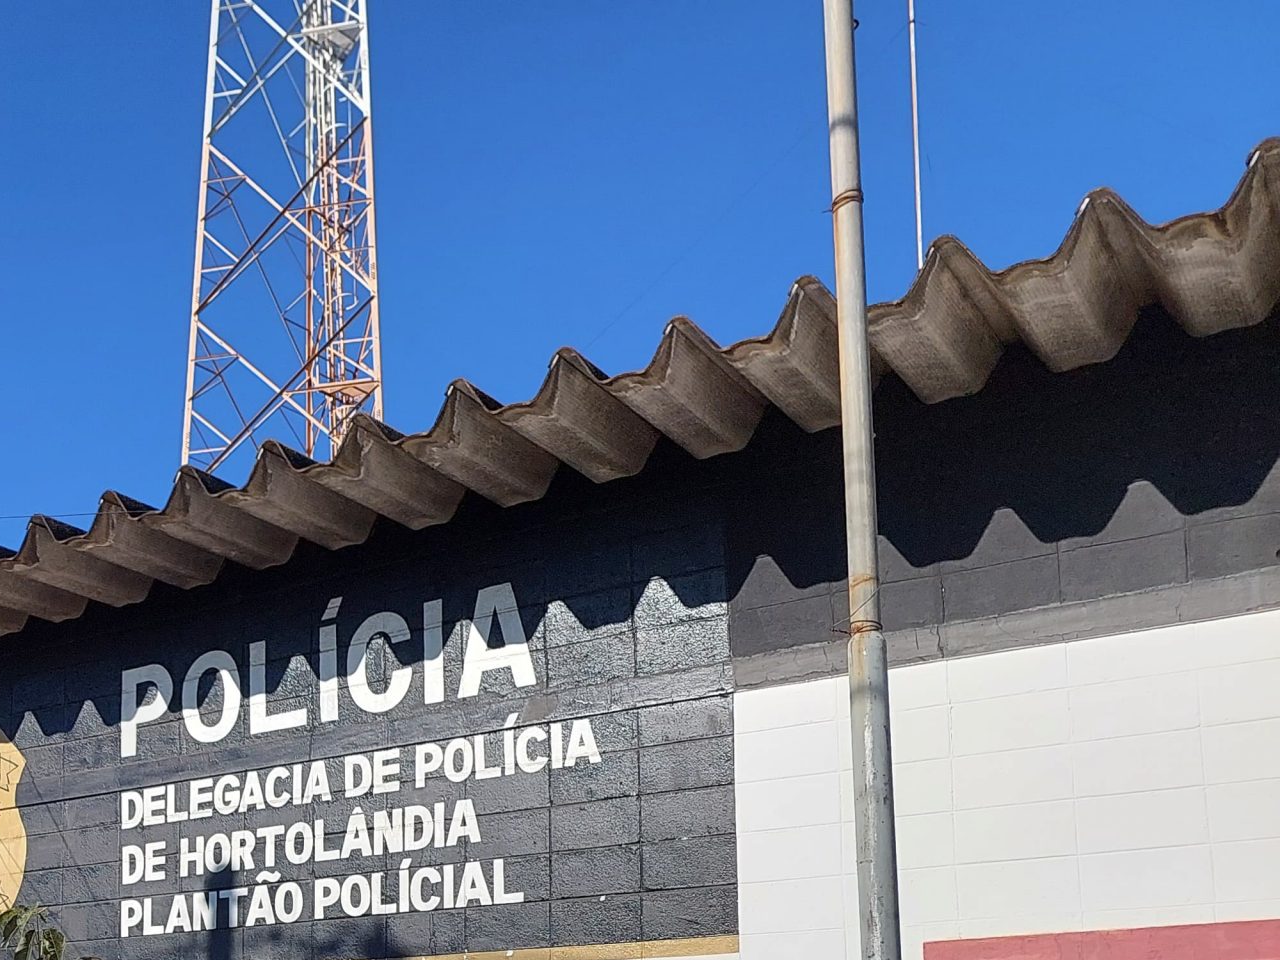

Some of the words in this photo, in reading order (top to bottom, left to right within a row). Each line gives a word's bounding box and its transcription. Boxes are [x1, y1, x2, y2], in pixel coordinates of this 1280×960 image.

[120, 582, 537, 758] POLÍCIA
[121, 760, 332, 830] DELEGACIA
[344, 749, 400, 798] DE
[415, 712, 602, 788] POLÍCIA
[122, 840, 166, 885] DE
[179, 798, 482, 878] HORTOLÂNDIA
[120, 870, 303, 938] PLANTÃO
[314, 858, 525, 921] POLÍCIAL
